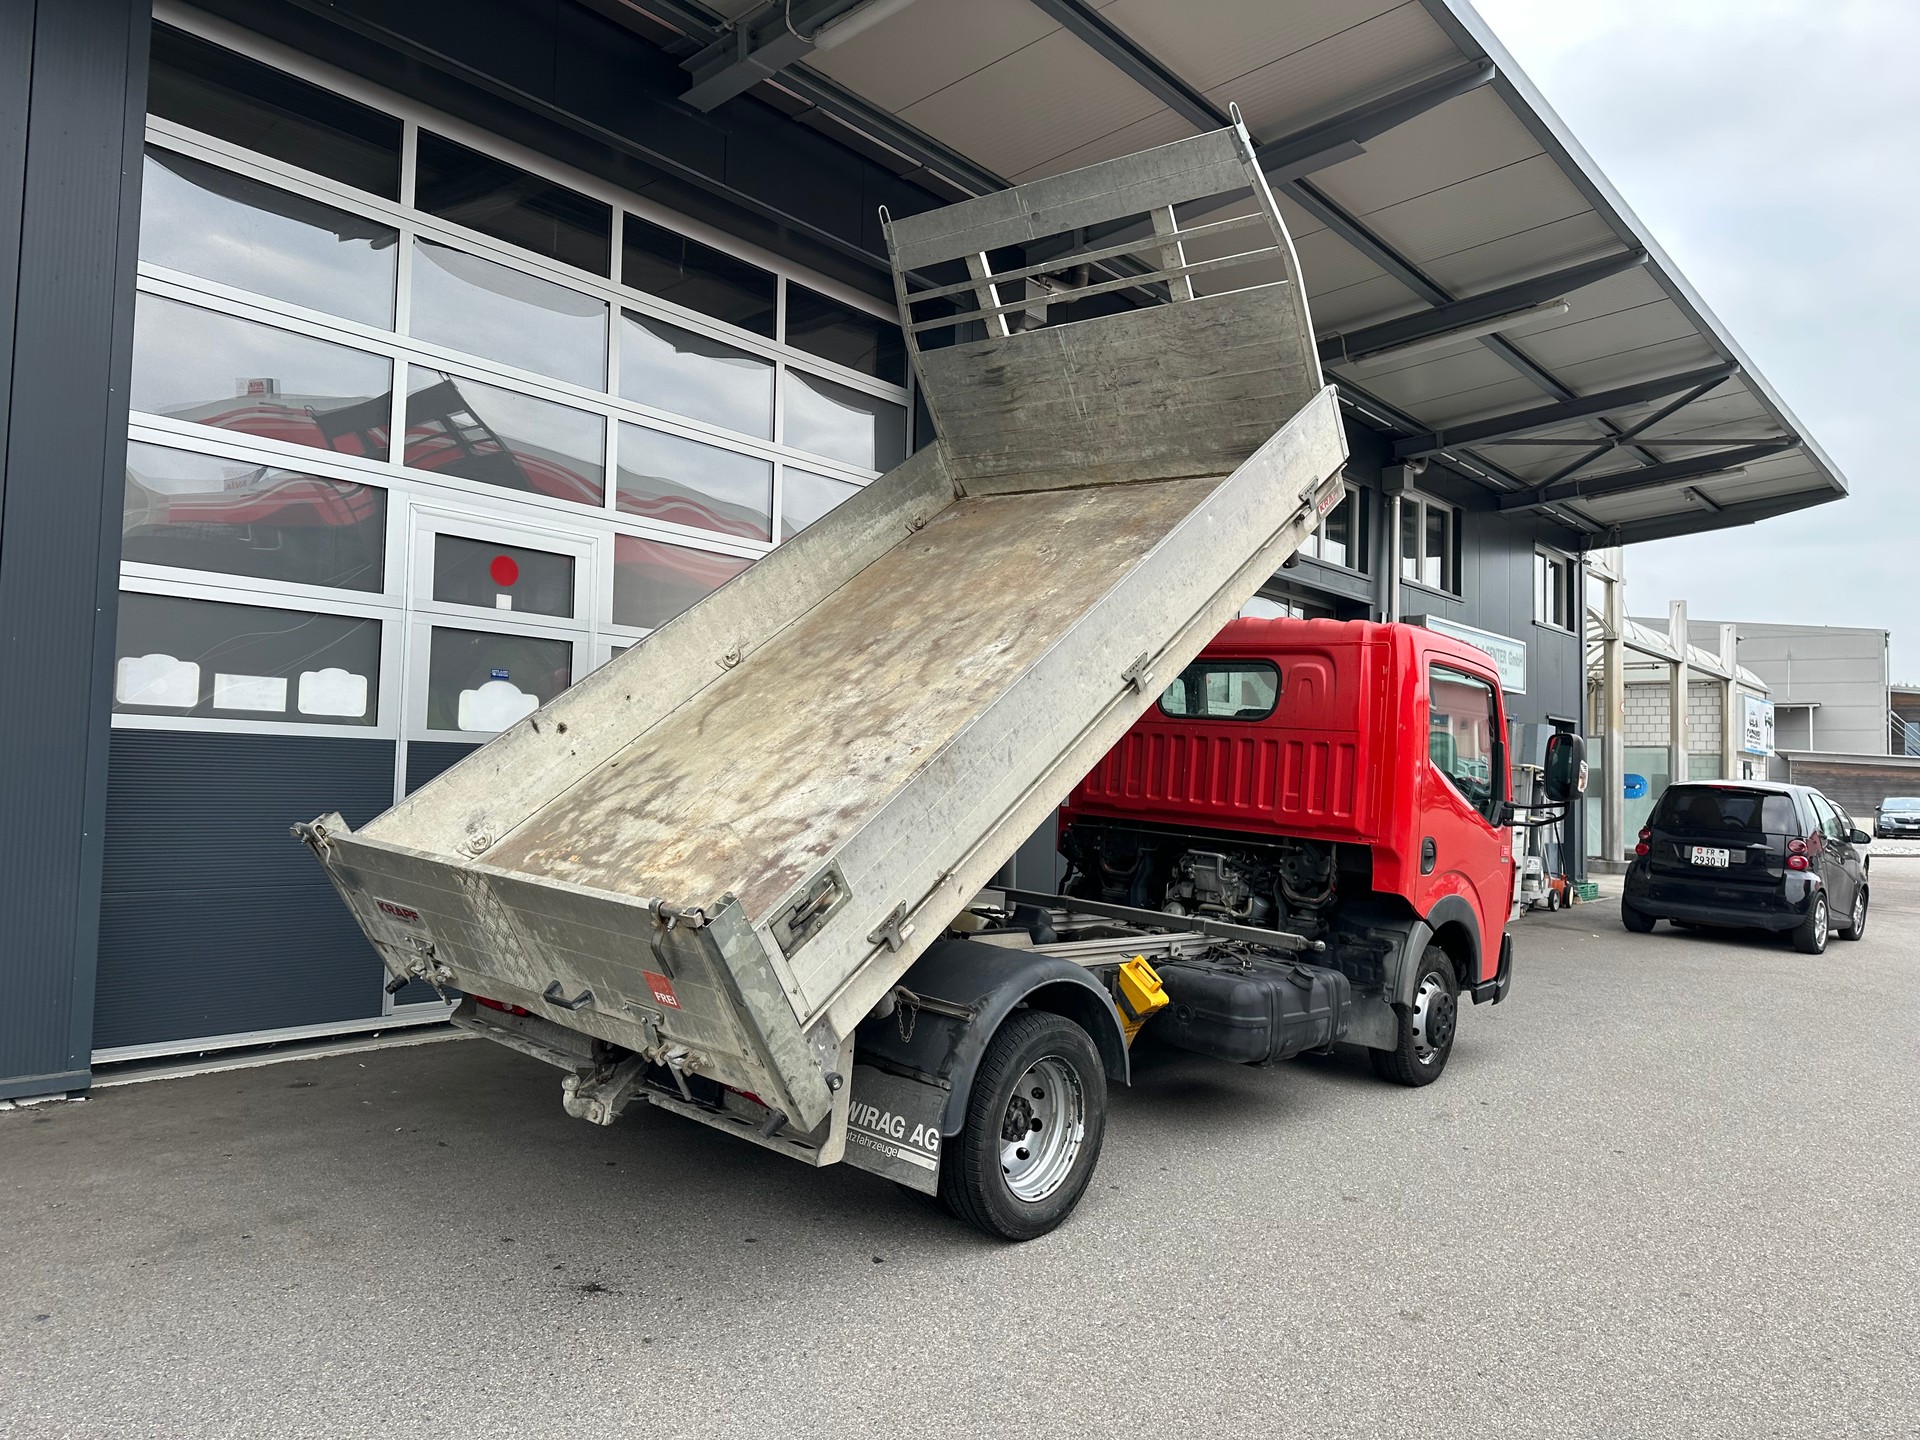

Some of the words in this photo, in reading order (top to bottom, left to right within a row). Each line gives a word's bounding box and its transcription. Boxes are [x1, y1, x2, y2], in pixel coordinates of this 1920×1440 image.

[377, 901, 418, 921] KRAPF
[654, 991, 677, 1005] FREI
[846, 1131, 898, 1157] utzfahrzeuge
[909, 1123, 940, 1151] AG
